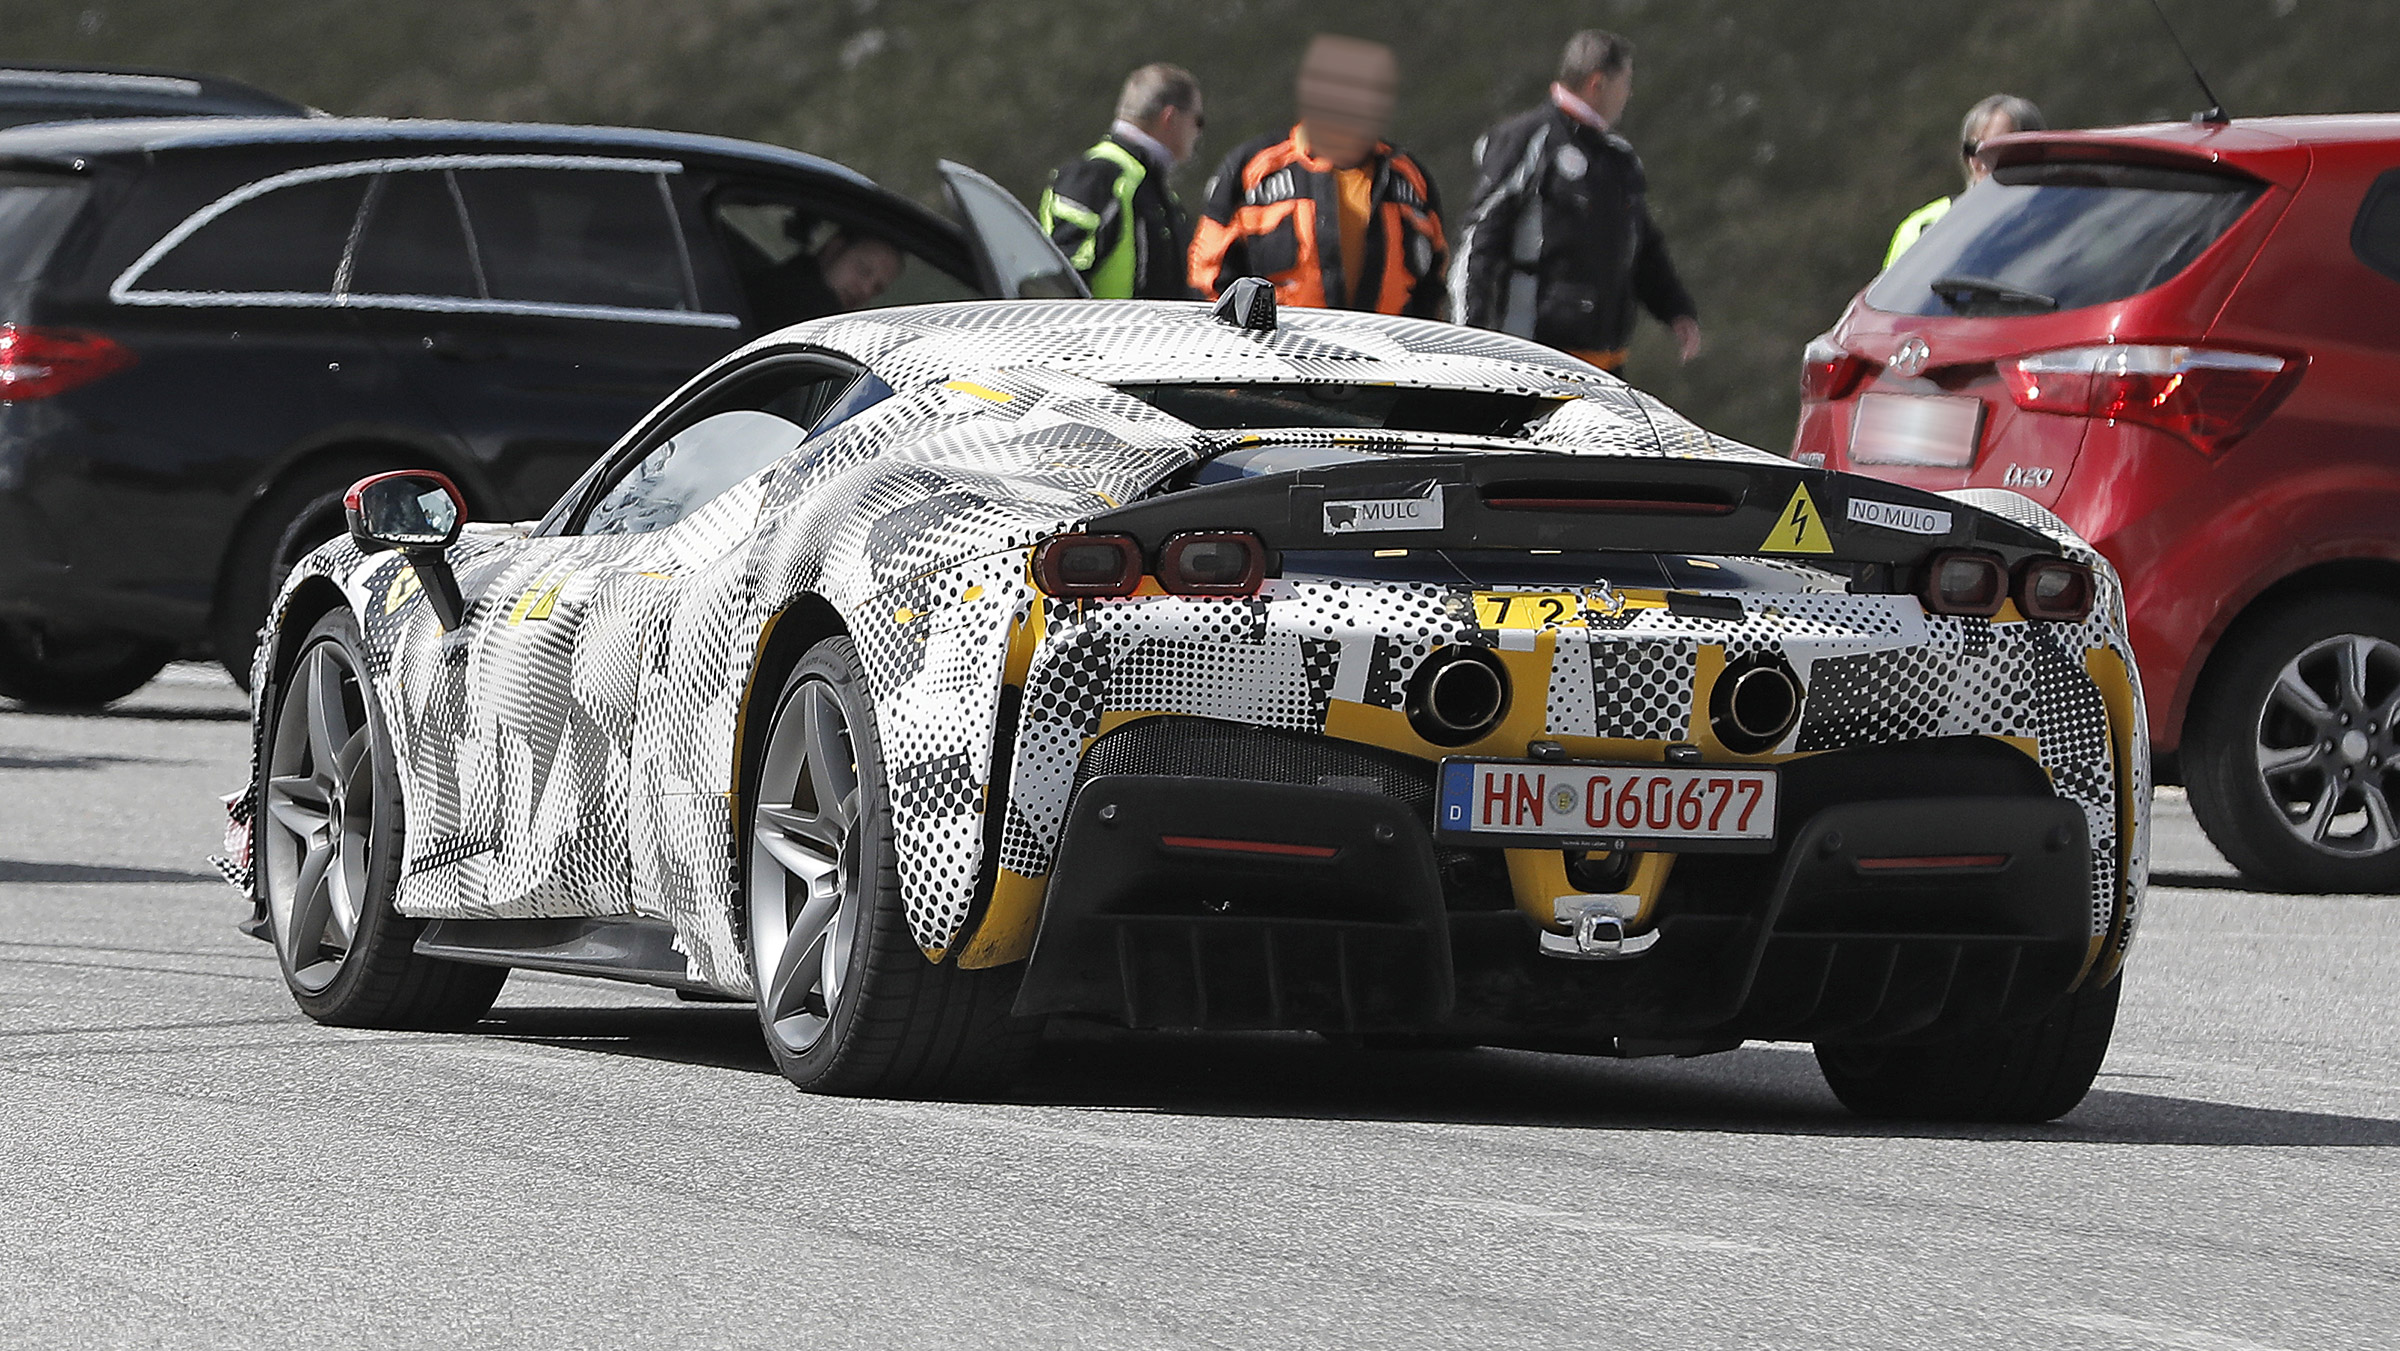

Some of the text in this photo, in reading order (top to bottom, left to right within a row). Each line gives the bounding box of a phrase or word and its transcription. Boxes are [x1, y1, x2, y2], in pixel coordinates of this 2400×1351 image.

[1853, 502, 1936, 531] NO MULO
[1487, 598, 1565, 625] 7 2
[1450, 805, 1462, 821] D
[1483, 773, 1764, 832] HN 060677
